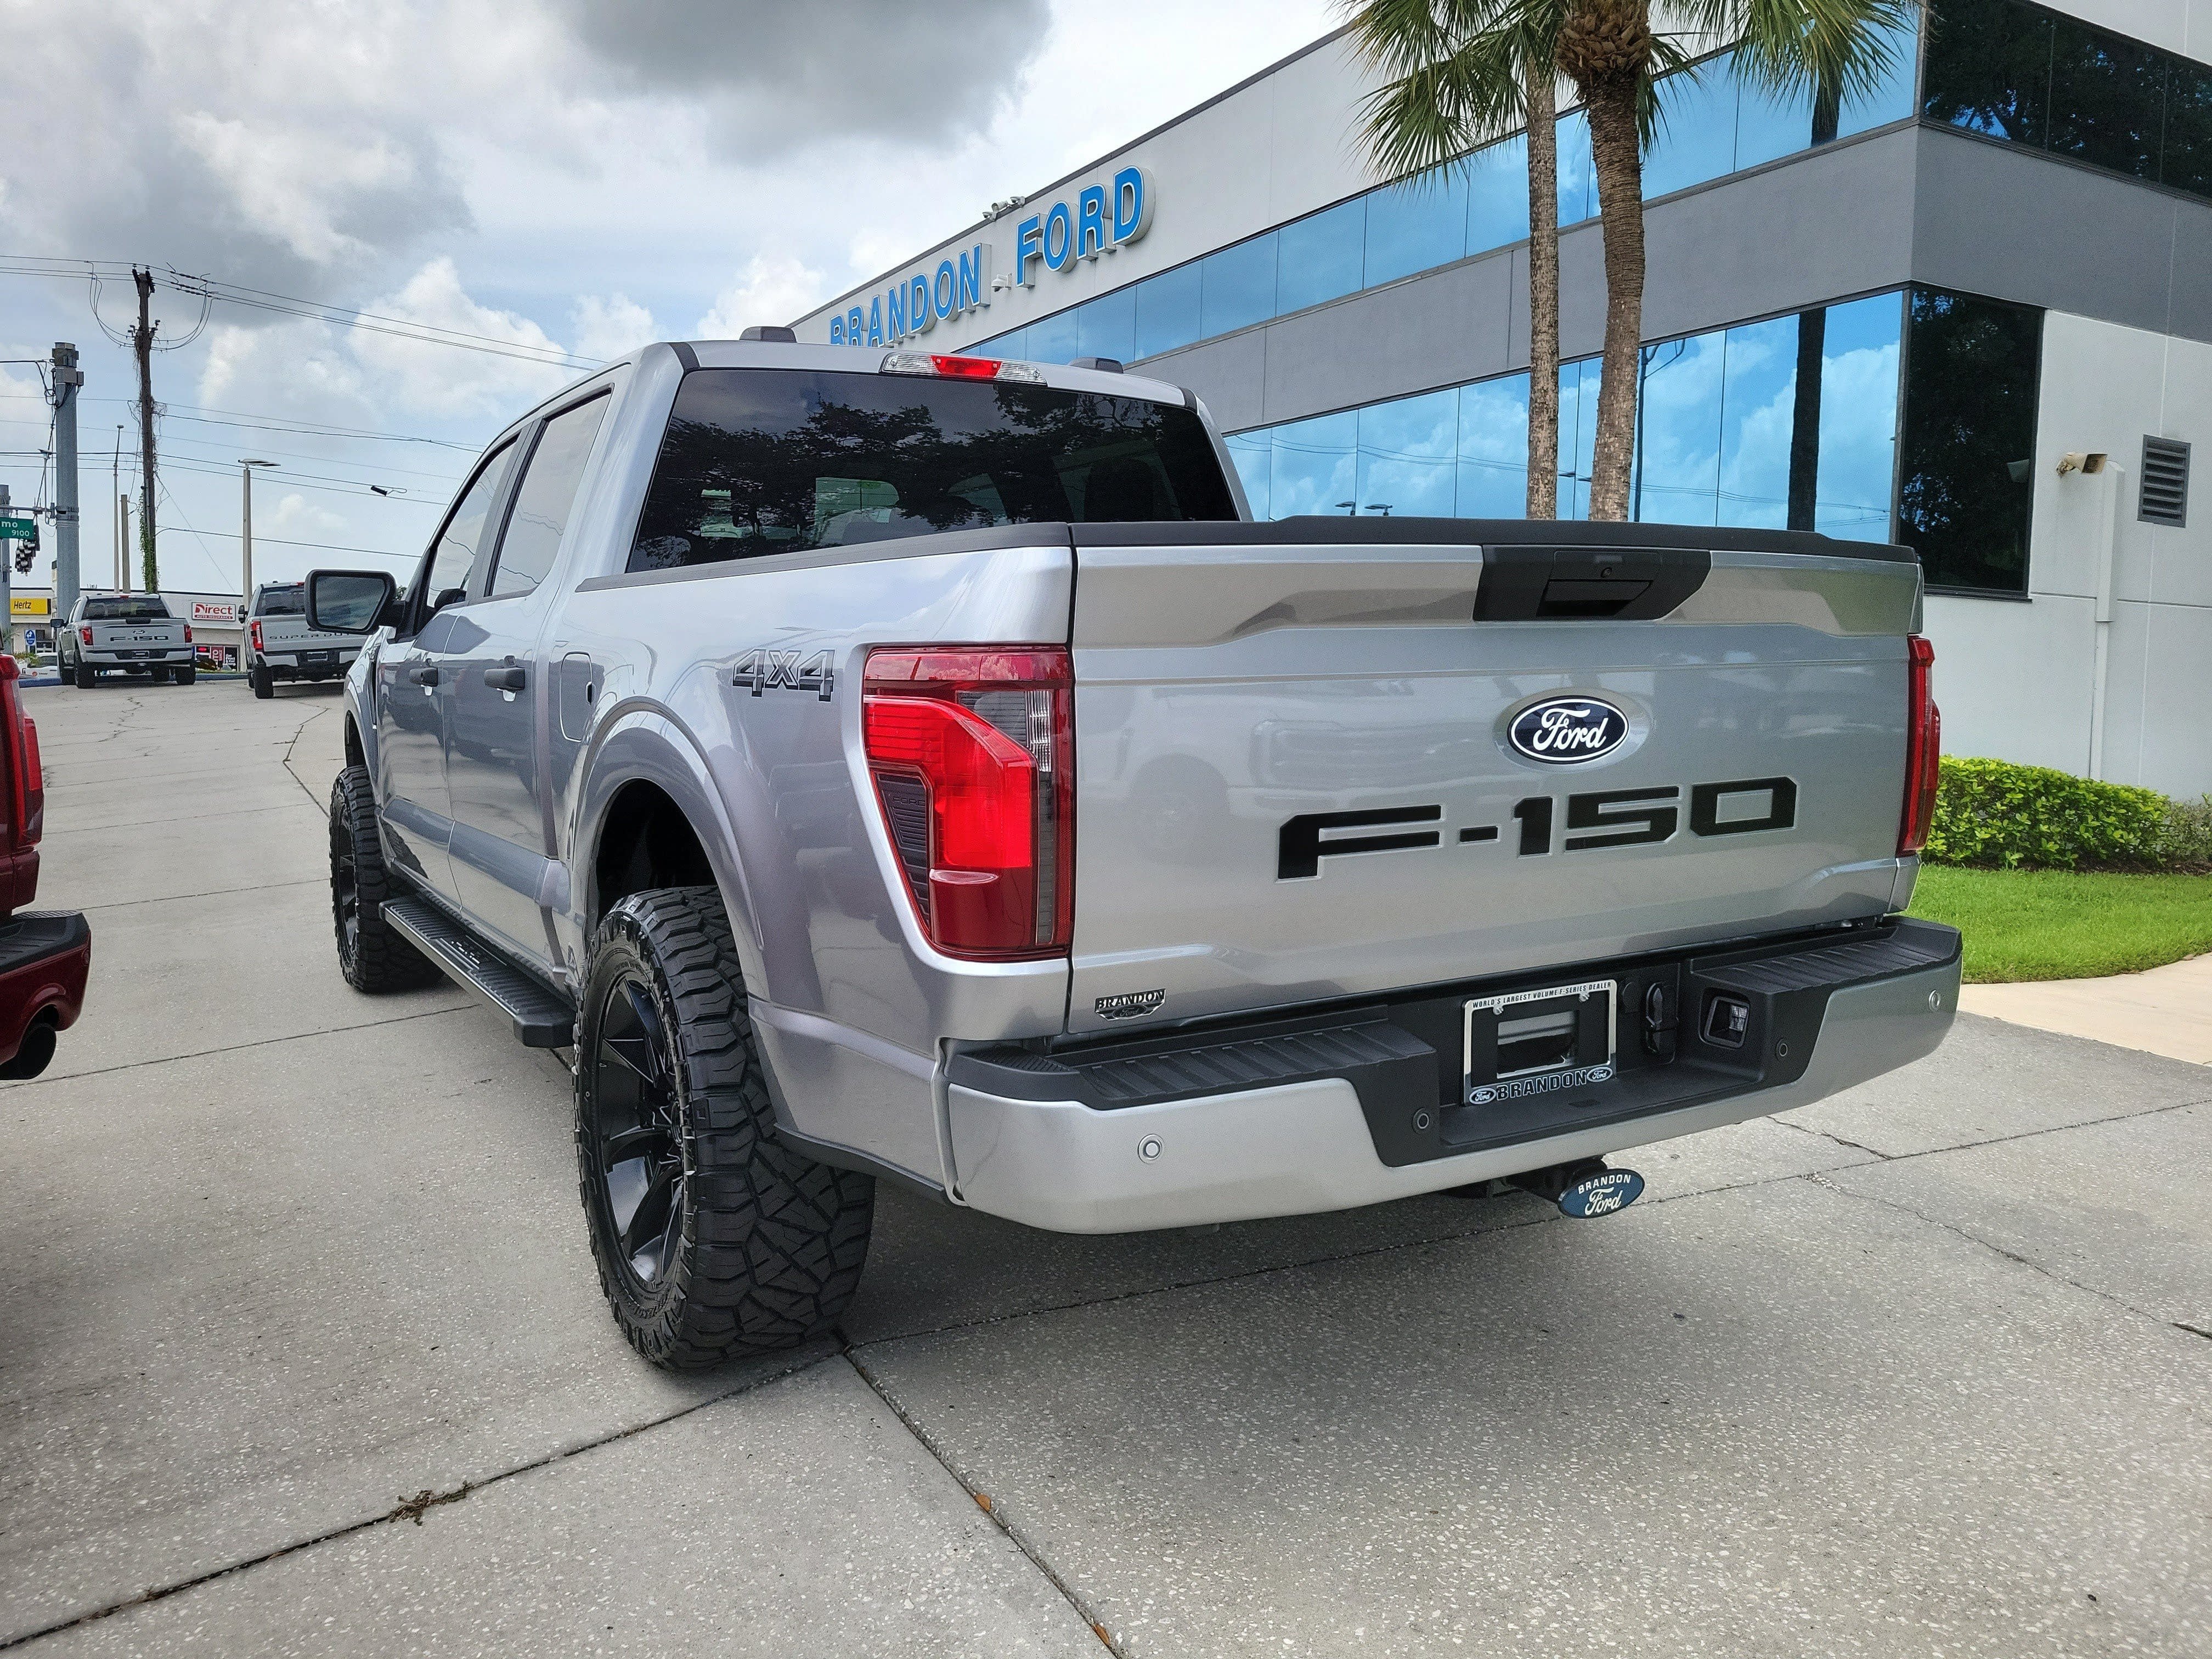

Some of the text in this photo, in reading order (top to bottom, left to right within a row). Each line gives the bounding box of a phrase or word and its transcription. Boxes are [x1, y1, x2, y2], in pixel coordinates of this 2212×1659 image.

[830, 165, 1147, 347] BRANDON FORD
[14, 600, 32, 609] Hertz
[195, 603, 233, 614] Direct
[1532, 706, 1608, 752] Ford
[1277, 776, 1797, 880] F-150
[1097, 990, 1165, 1009] BRANDON
[1472, 981, 1611, 1008] WORLD'S LARGEST VOLUME F-SERIES DEALER
[1496, 1070, 1587, 1101] BRANDON
[1578, 1174, 1631, 1195] BRANDON
[1584, 1187, 1623, 1216] Ford
